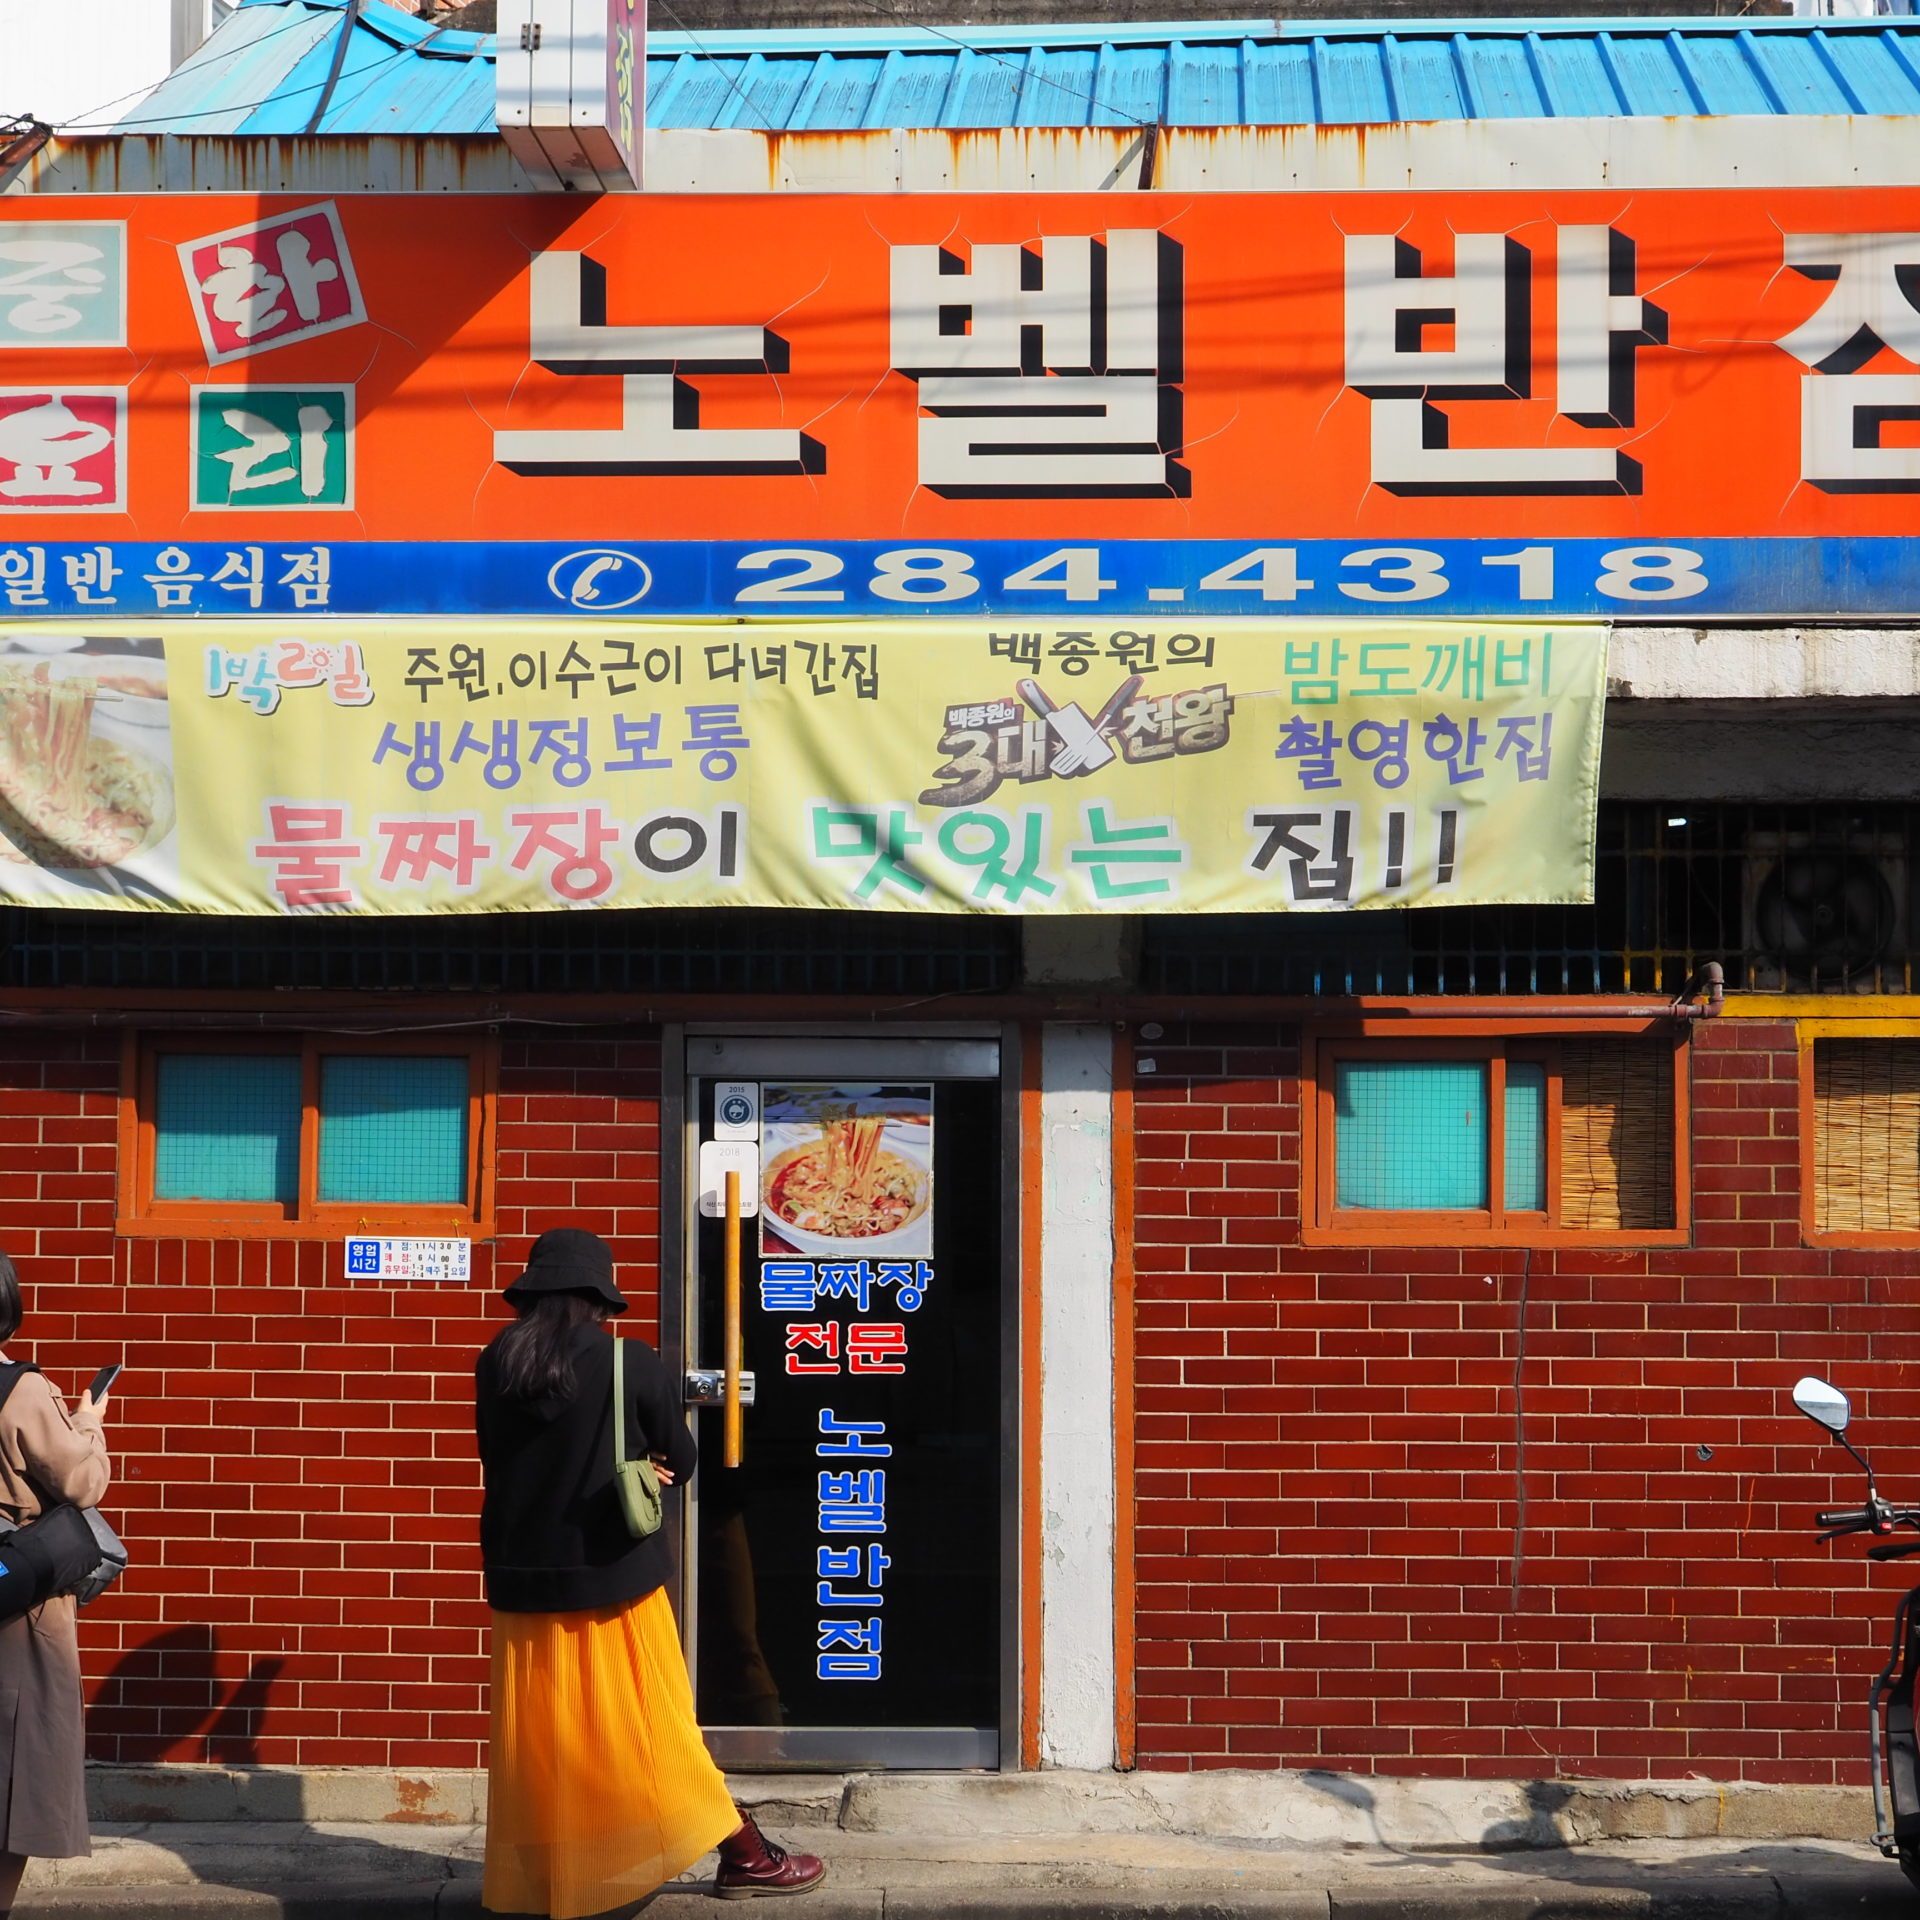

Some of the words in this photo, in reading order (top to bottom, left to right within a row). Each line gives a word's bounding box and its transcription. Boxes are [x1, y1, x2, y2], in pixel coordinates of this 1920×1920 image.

[988, 629, 1216, 677] 백종원의
[1284, 632, 1554, 705] 밤도깨비
[371, 703, 751, 792] 생생정보통
[812, 805, 1182, 904] 맛있는
[351, 1258, 377, 1271] 시간
[352, 1244, 377, 1257] 영업
[759, 1260, 935, 1313] 물짜장
[784, 1320, 909, 1376] 전문
[815, 1408, 893, 1681] 노벨반점
